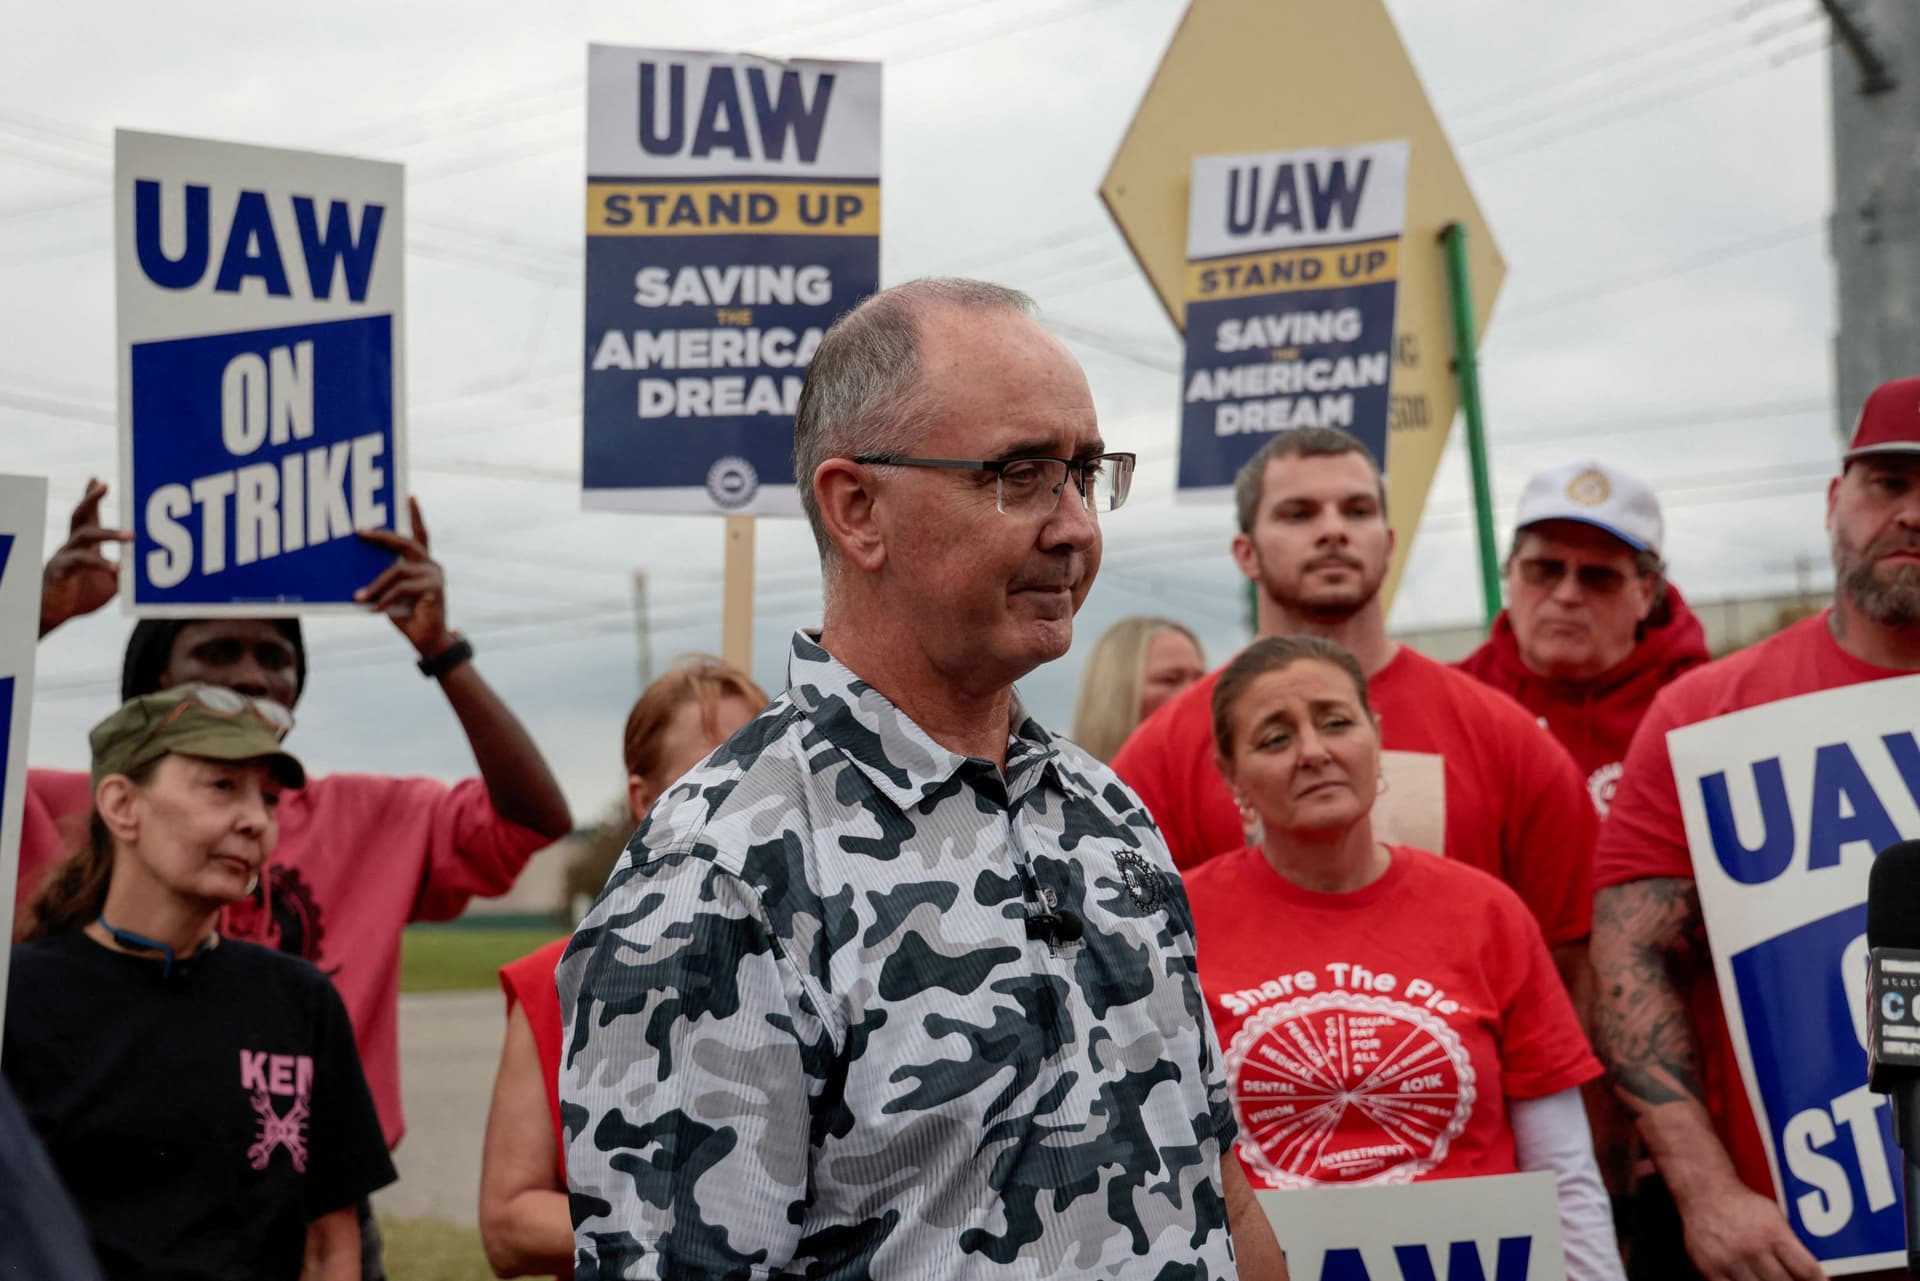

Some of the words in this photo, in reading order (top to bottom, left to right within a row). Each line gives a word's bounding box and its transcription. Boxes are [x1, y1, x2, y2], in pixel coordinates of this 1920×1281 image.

[637, 61, 836, 163] UAW
[603, 193, 779, 227] STAND
[797, 193, 864, 226] UP
[1225, 157, 1372, 239] UAW
[134, 178, 386, 304] UAW
[634, 266, 832, 308] SAVING
[1199, 258, 1323, 294] STAND
[1339, 250, 1388, 279] UP
[716, 309, 752, 326] THE
[1215, 308, 1363, 352] SAVING
[592, 326, 824, 371] AMERICA
[221, 340, 315, 457] ON
[1186, 353, 1389, 402] AMERICAN
[1215, 394, 1354, 437] DREAM
[145, 431, 387, 589] STRIKE
[1326, 962, 1397, 992] The
[1404, 978, 1460, 1016] Pie
[1881, 977, 1920, 988] stat
[1258, 1044, 1315, 1083] MEDICAL
[1351, 1038, 1381, 1050] FOR
[1352, 1051, 1380, 1063] ALL
[1242, 1079, 1298, 1095] DENTAL
[1399, 1072, 1444, 1094] 401K
[1247, 1103, 1297, 1124] VISION
[1319, 1143, 1406, 1167] INVESTMENT
[1782, 1082, 1896, 1239] ST
